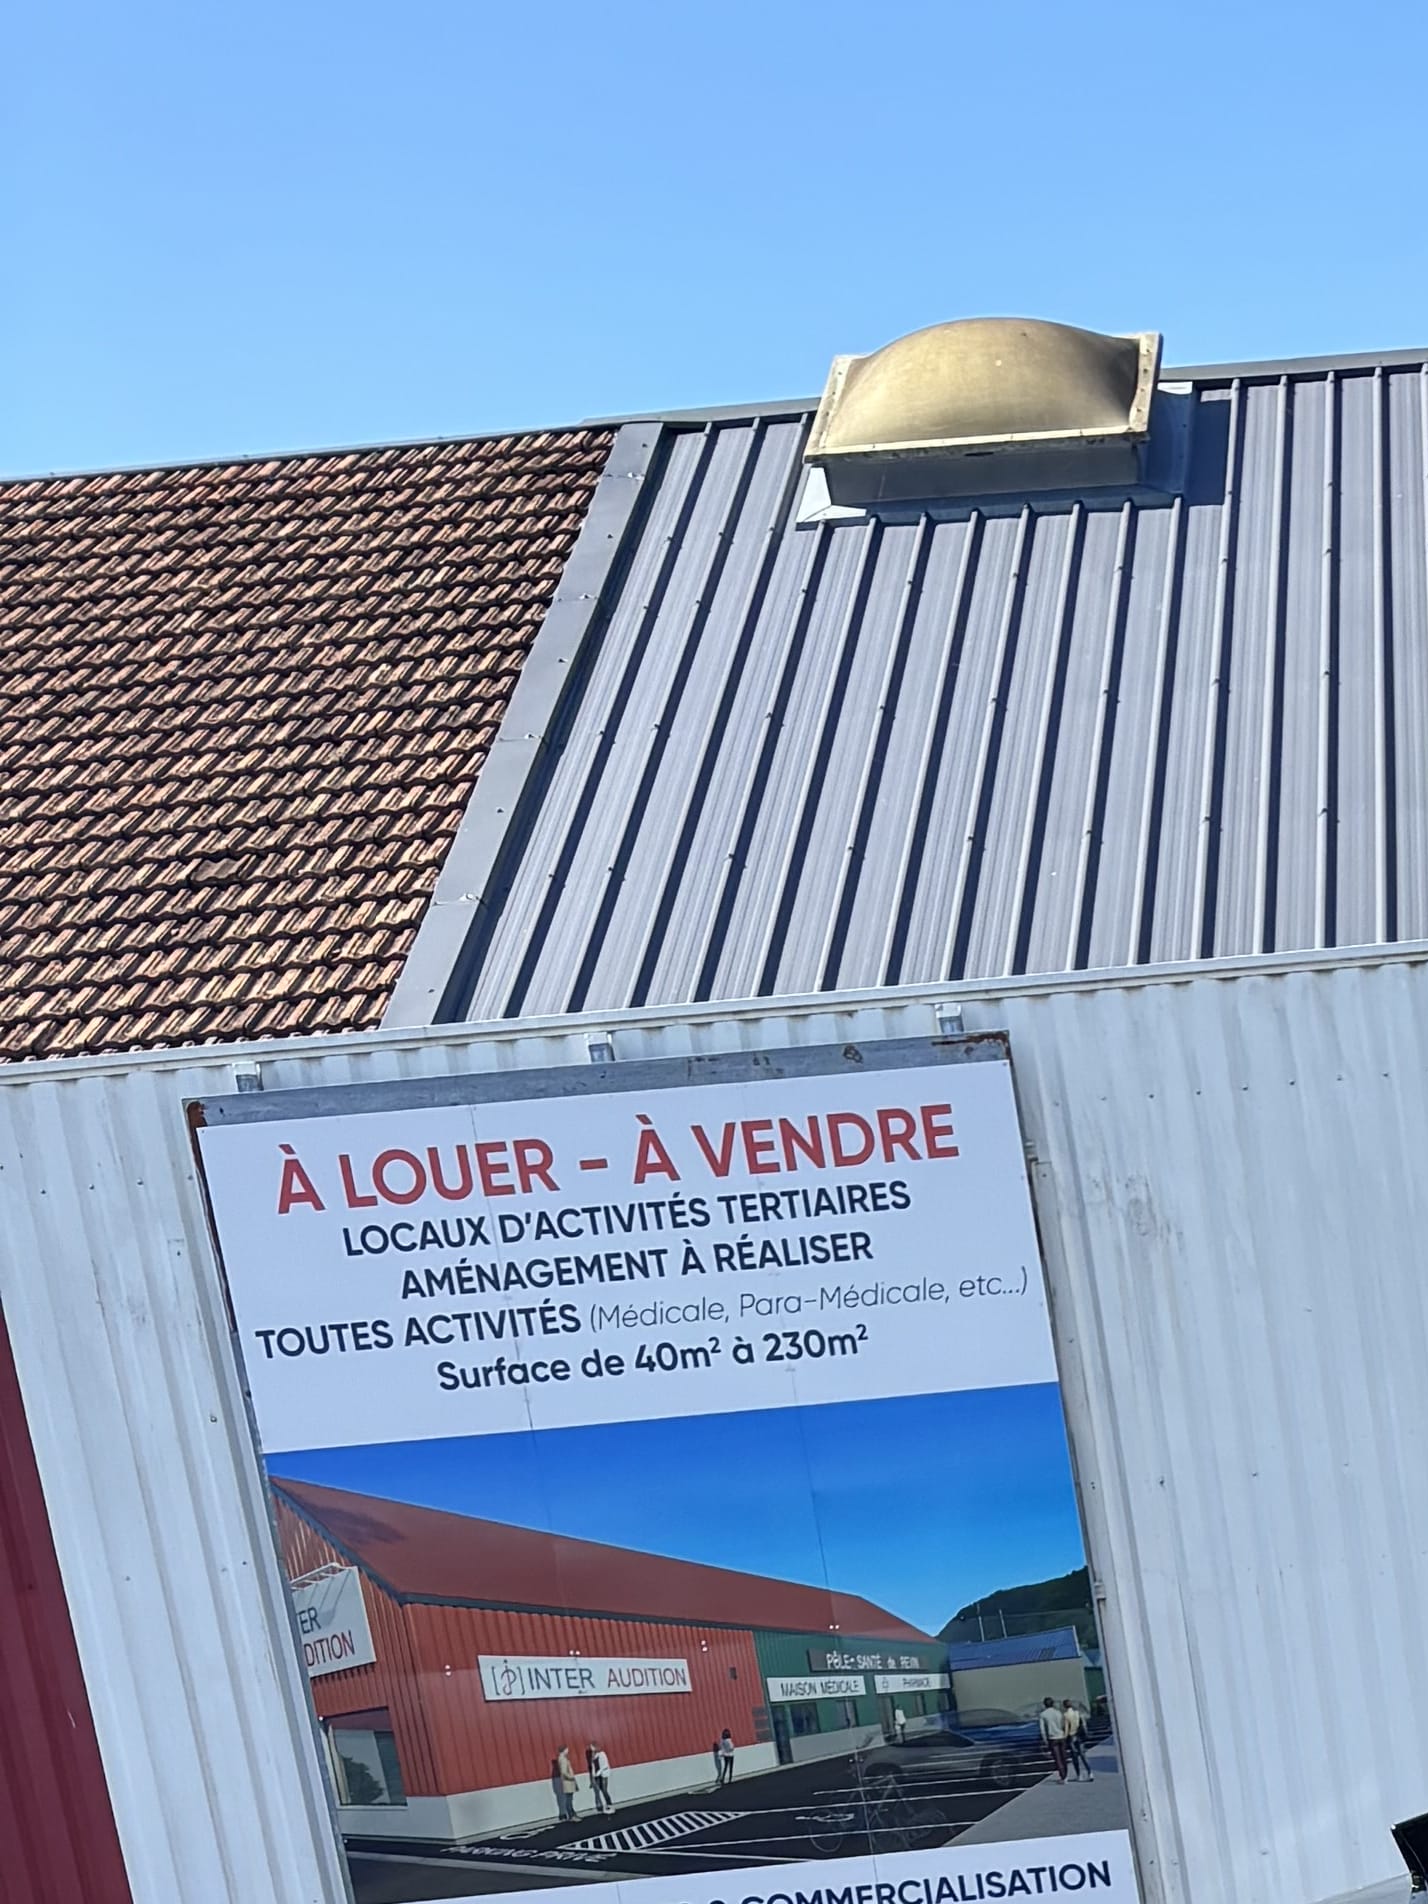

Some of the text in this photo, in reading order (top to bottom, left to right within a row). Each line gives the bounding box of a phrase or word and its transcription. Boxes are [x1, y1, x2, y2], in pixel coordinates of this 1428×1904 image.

[277, 1142, 326, 1214] À
[338, 1138, 560, 1209] LOUER
[633, 1112, 681, 1184] À
[690, 1103, 960, 1178] VENDRE
[342, 1179, 912, 1257] LOCAUX D'ACTIVITÉS TERTIAIRES
[401, 1231, 874, 1300] AMÉNAGEMENT À RÉALISER
[255, 1319, 394, 1359] TOUTES
[404, 1298, 582, 1347] ACTIVITÉS
[590, 1296, 730, 1334] (Médicale,
[739, 1277, 950, 1319] Para-Médicale,
[436, 1323, 869, 1392] Surface de 40m² à 230m²
[527, 1667, 687, 1690] INTER AUDITION
